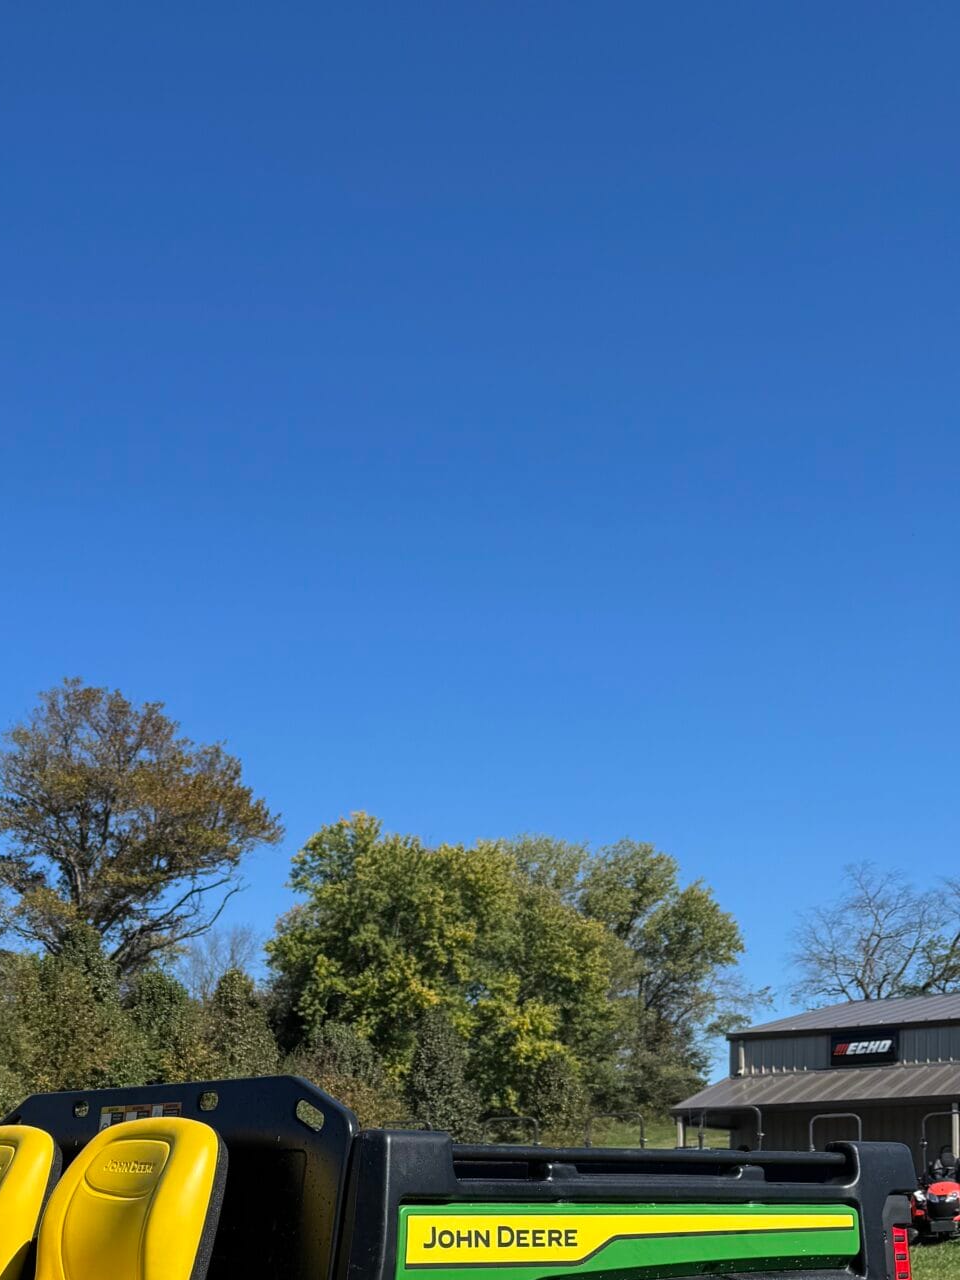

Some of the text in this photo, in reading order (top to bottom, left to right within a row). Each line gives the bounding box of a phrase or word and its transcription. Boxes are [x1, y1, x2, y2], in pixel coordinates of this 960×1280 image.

[846, 1040, 892, 1055] ECHO
[423, 1225, 578, 1249] JOHN DEERE
